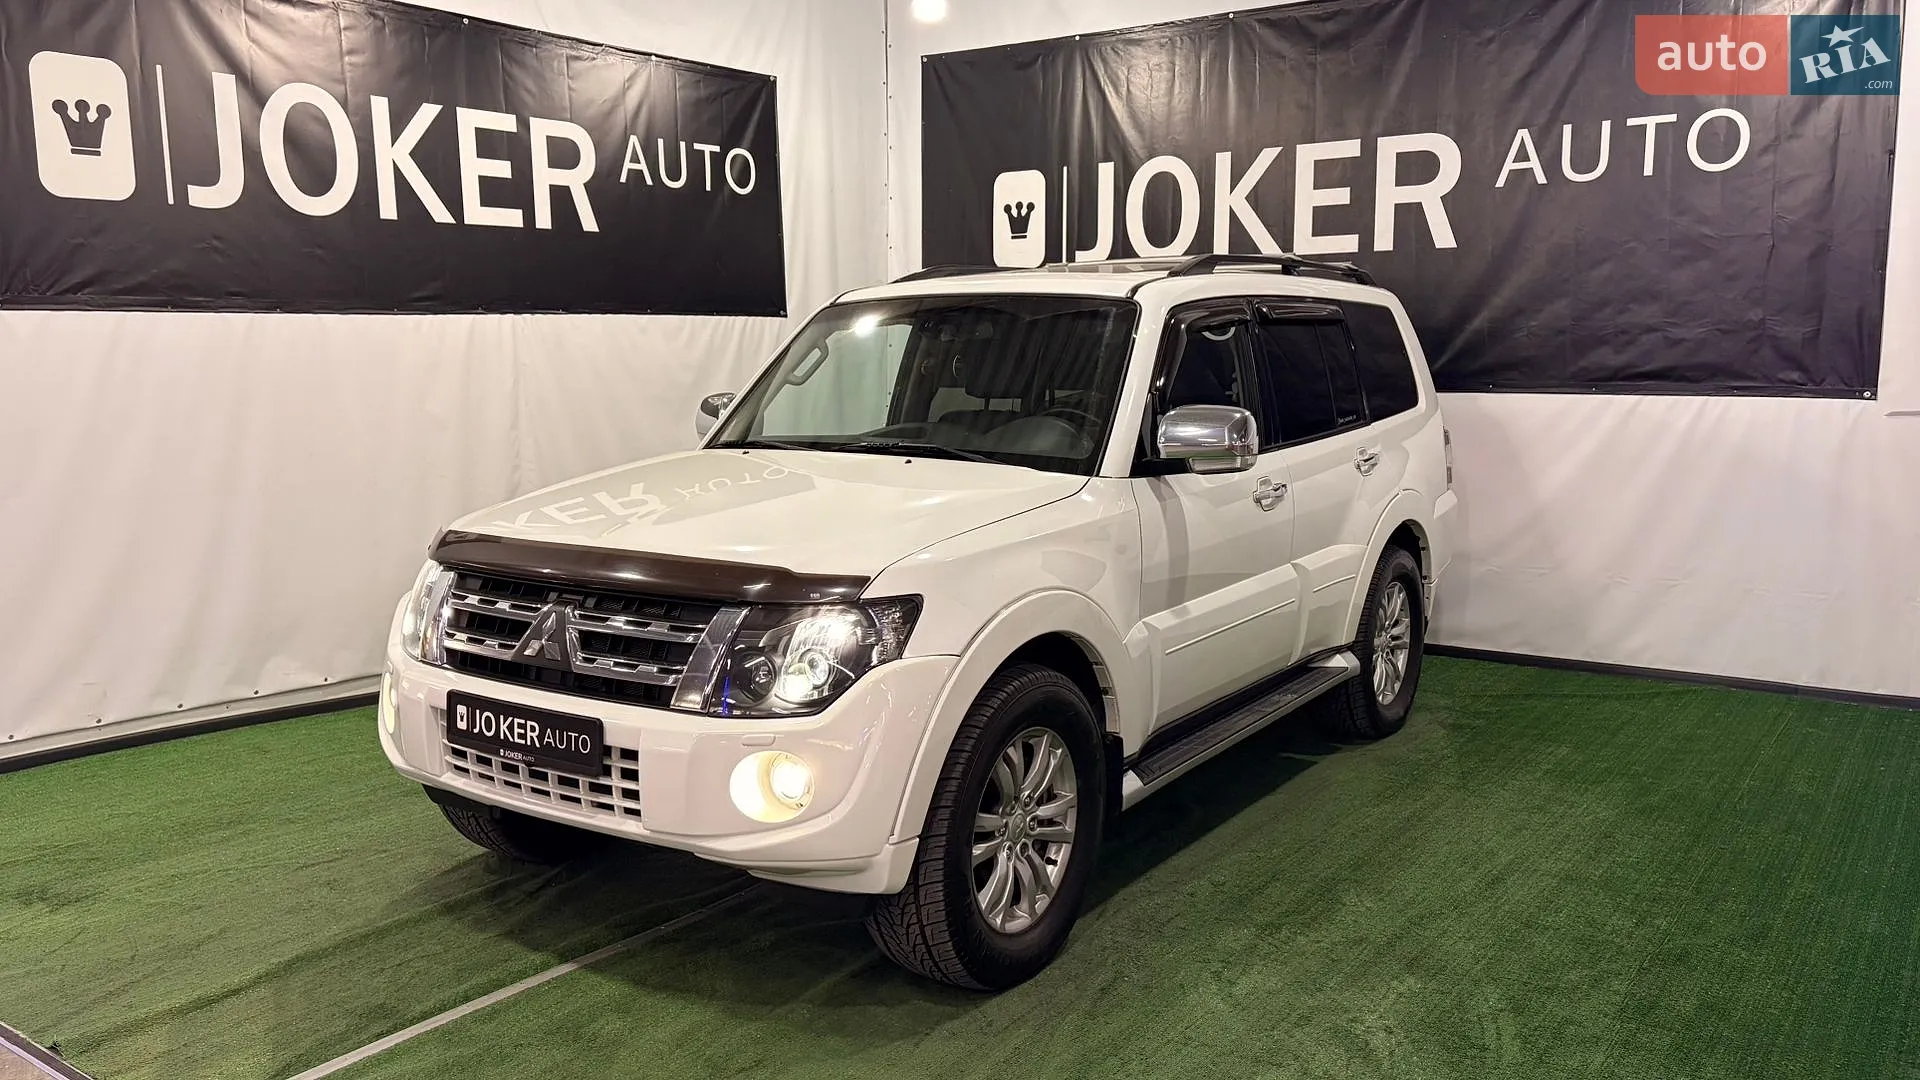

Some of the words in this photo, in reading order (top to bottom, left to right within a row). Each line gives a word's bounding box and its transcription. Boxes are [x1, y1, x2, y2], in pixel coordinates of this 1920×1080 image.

[187, 72, 600, 233] JOKER
[619, 134, 757, 196] AUTO
[1074, 132, 1462, 263] JOKER
[1495, 107, 1751, 188] AUTO
[473, 709, 541, 748] JOKER
[543, 727, 591, 754] AUTO
[504, 750, 523, 761] JOKER
